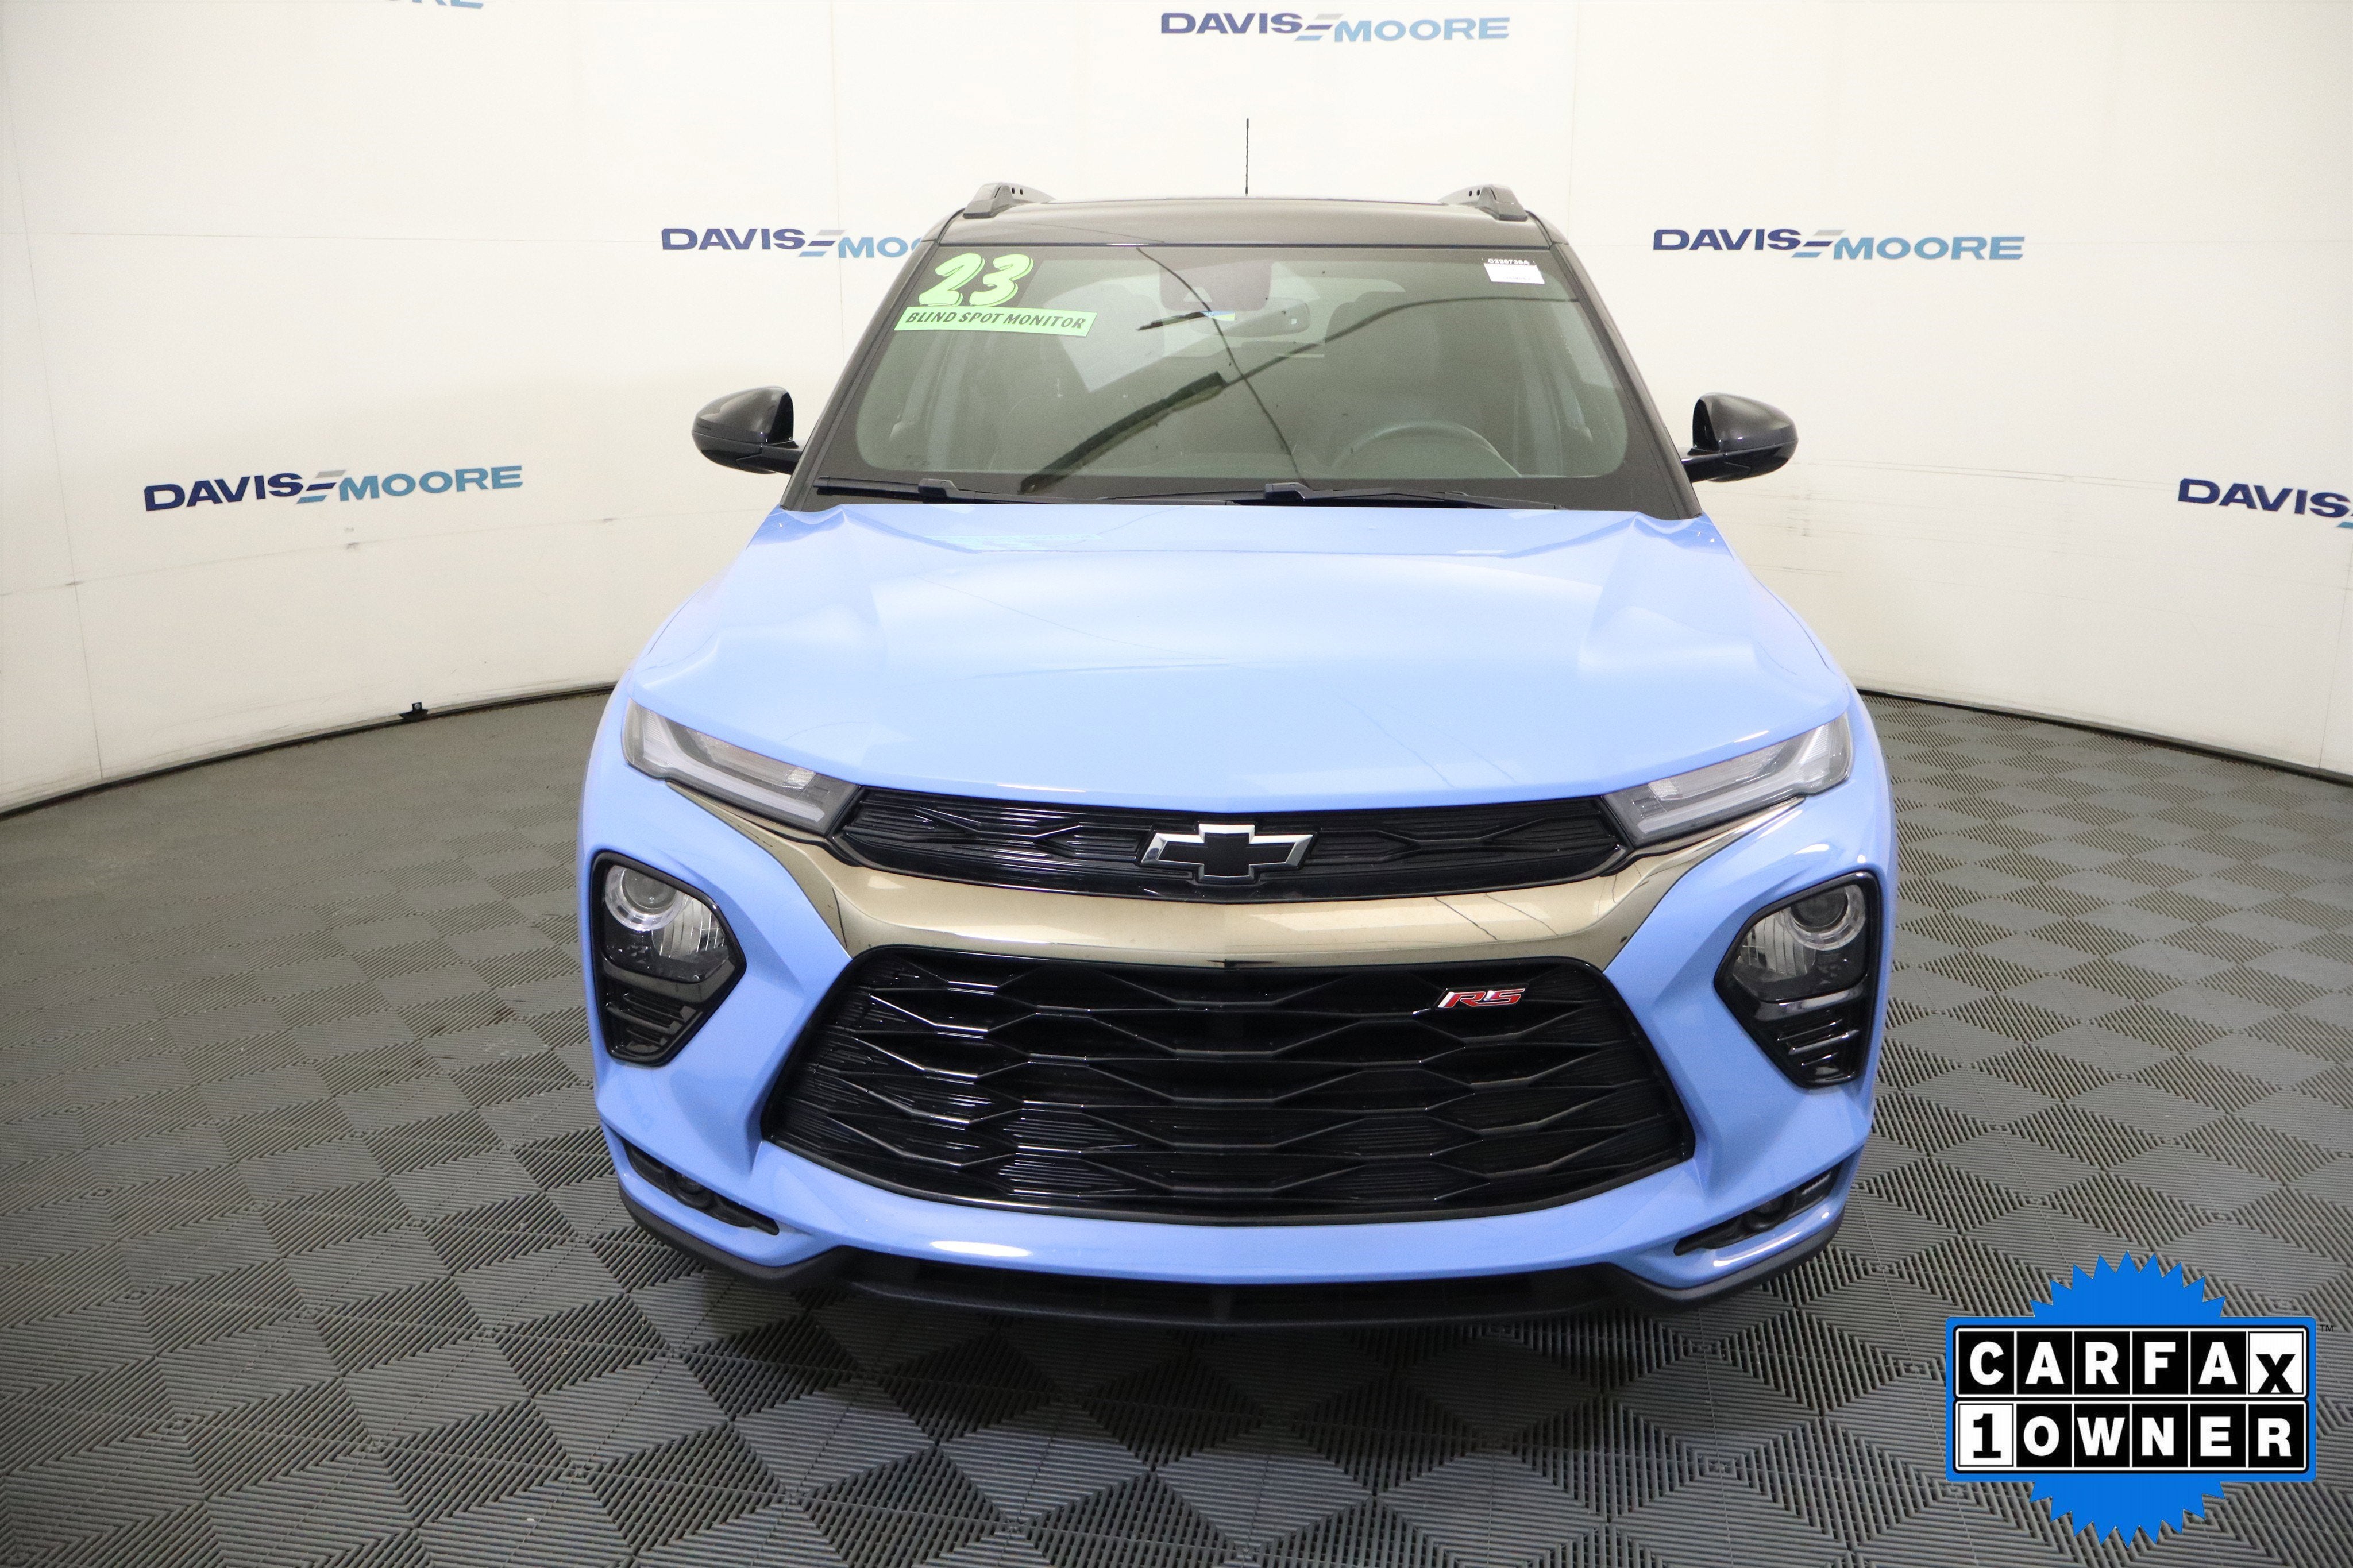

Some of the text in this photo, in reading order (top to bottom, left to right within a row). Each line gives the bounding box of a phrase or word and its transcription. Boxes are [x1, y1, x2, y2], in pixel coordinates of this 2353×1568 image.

[1161, 13, 1510, 42] DAVIS MOORE
[661, 228, 805, 250] DAVIS
[1653, 229, 2025, 260] DAVIS MOORE
[919, 253, 1034, 307] 23
[905, 312, 1086, 329] BLIND SPOT MONITOR
[144, 465, 524, 511] DAVIS MOORE
[2178, 478, 2351, 517] DAVIS
[1437, 988, 1526, 1008] RS
